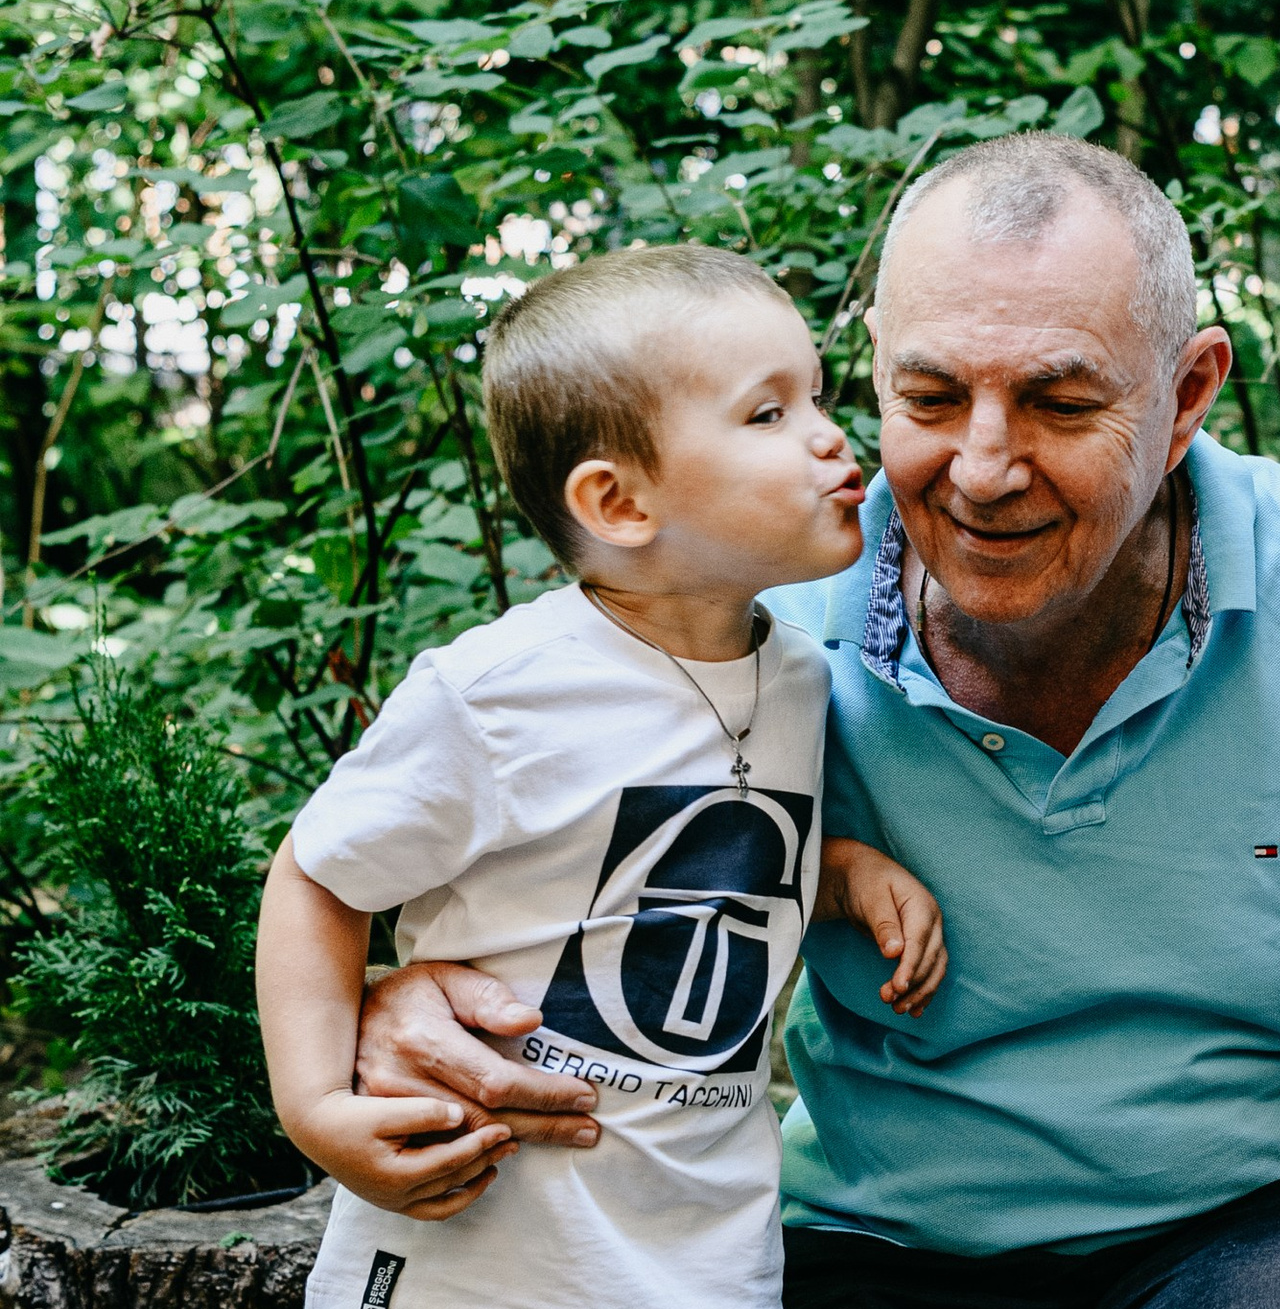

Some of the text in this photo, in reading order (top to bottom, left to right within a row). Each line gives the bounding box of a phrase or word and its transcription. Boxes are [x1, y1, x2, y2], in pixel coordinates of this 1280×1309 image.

[521, 1036, 753, 1108] SERGIO TACCHINI
[368, 1266, 387, 1305] SERGIO
[375, 1260, 398, 1306] TACCHINI
